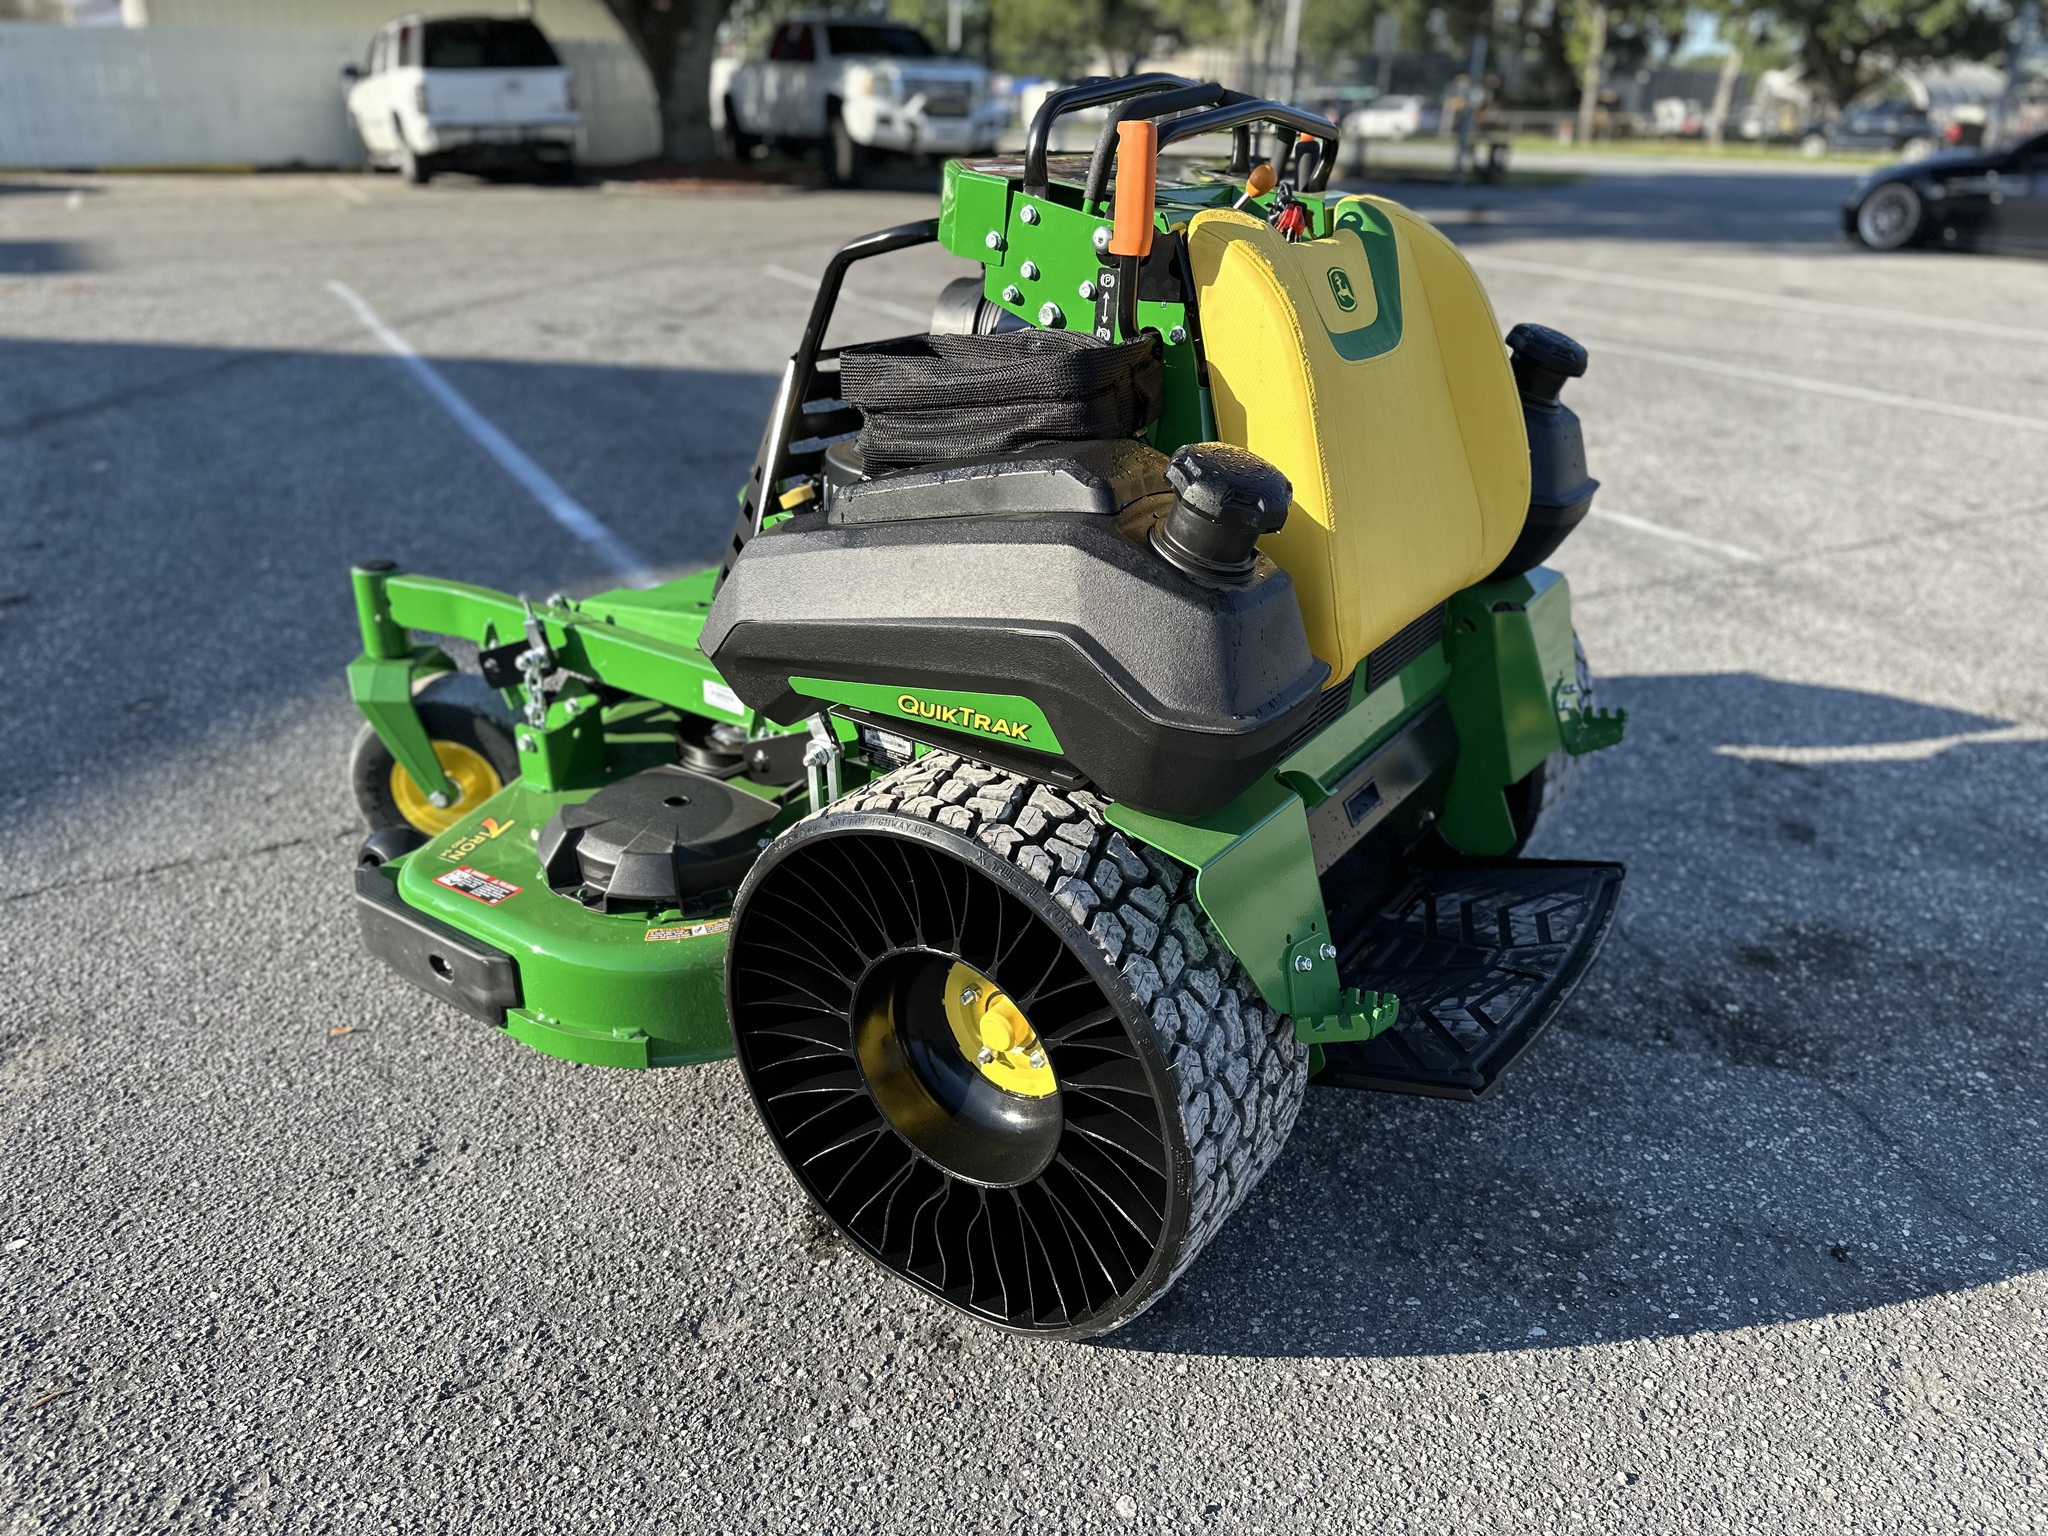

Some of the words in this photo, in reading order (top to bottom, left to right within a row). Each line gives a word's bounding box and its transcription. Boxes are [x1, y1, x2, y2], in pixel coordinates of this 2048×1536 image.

[897, 694, 1032, 742] QUIKTRAK
[449, 831, 491, 861] IRON
[871, 818, 912, 832] HIGHWAY
[914, 824, 934, 838] USE
[976, 849, 990, 866] X
[990, 860, 1041, 903] TWEEL
[1042, 899, 1083, 938] TURF
